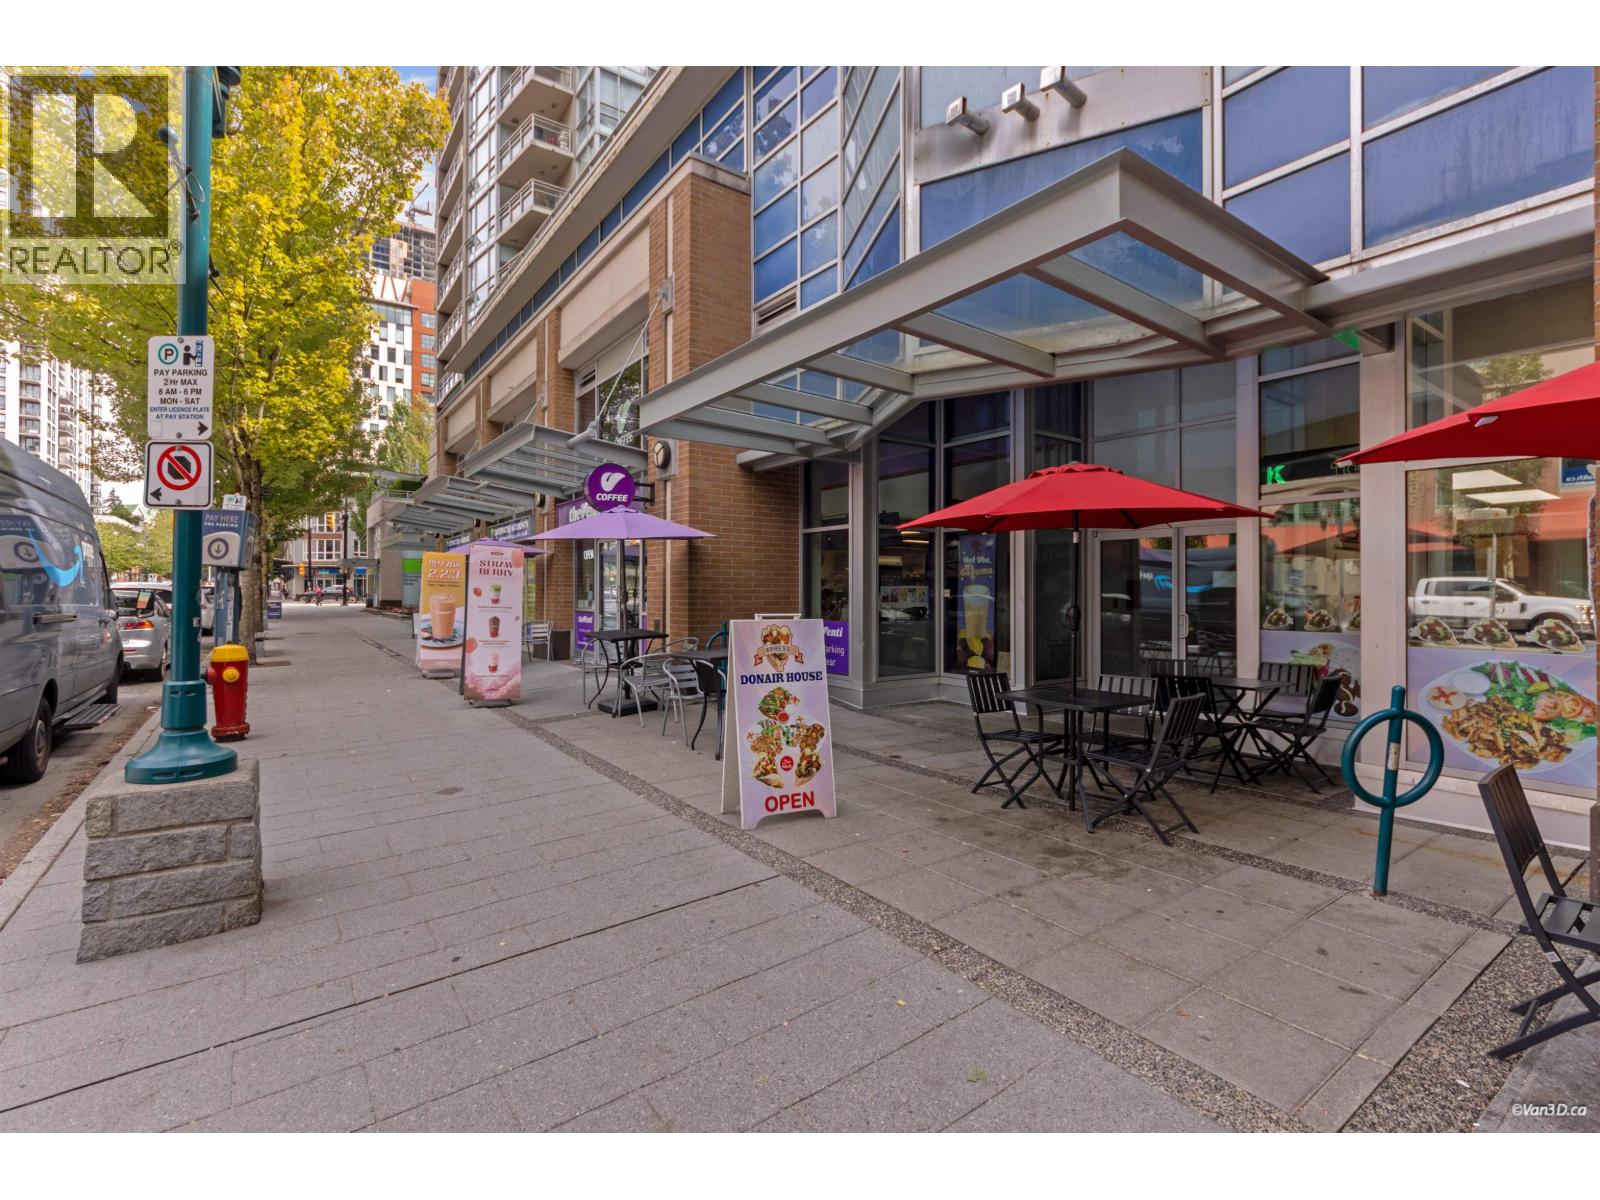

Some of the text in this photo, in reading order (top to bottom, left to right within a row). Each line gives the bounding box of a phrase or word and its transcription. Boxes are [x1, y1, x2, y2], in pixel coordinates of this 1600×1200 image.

[595, 493, 629, 502] COFFEE
[220, 514, 239, 522] HERE
[479, 560, 513, 569] STRAW
[479, 568, 513, 577] BERRY
[825, 643, 845, 657] arking
[740, 671, 823, 685] DONAIR HOUSE
[765, 791, 815, 812] OPEN
